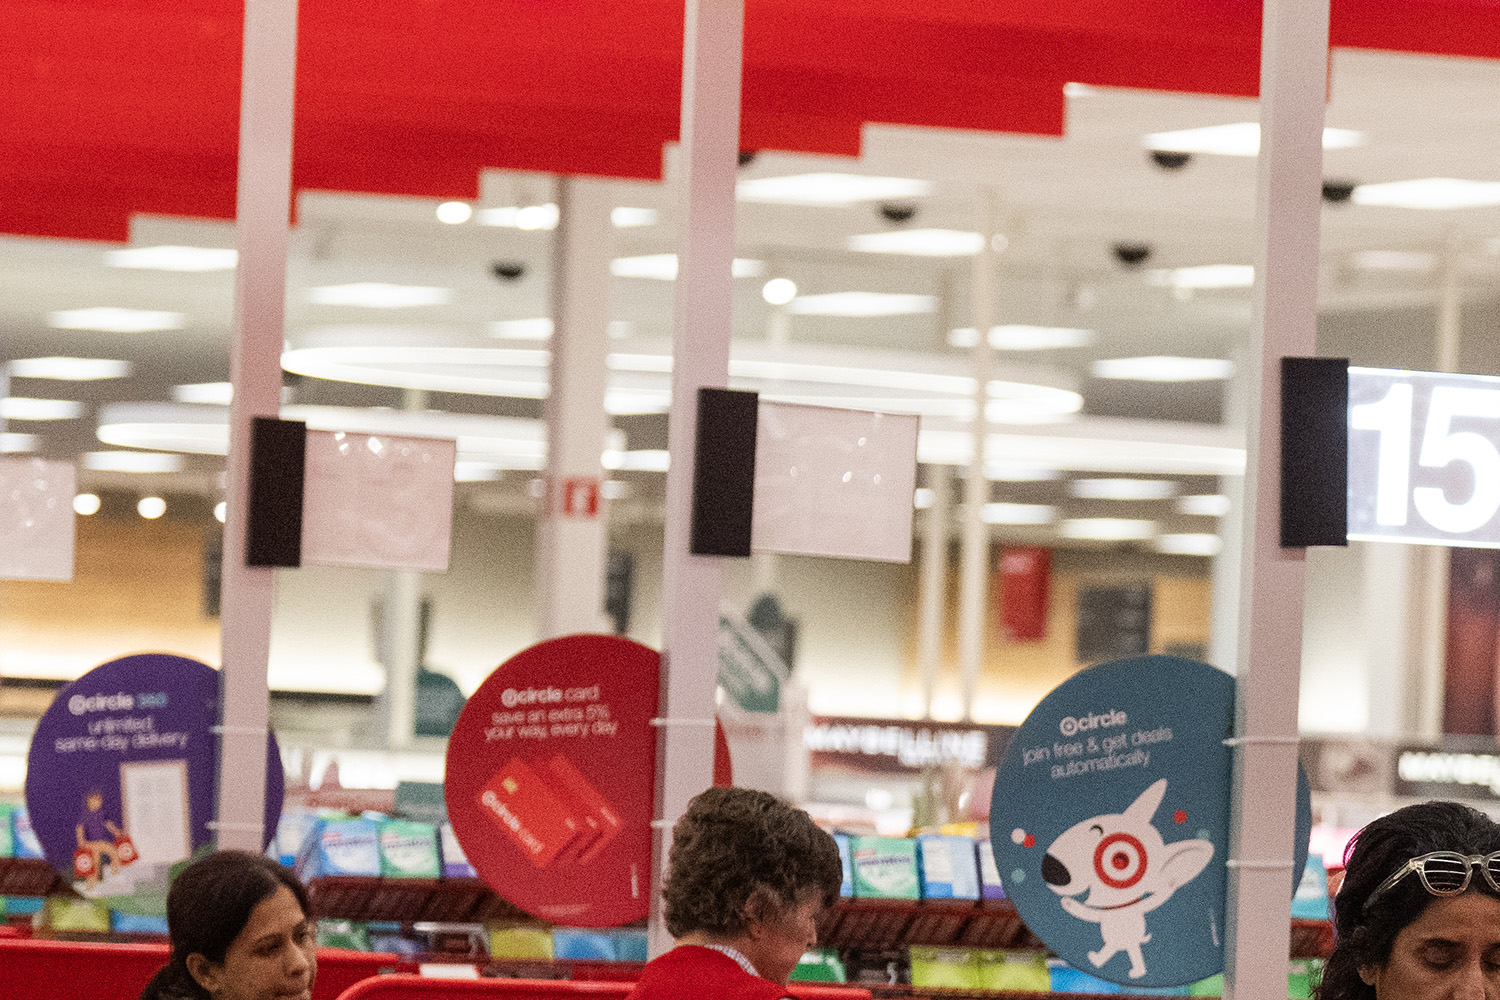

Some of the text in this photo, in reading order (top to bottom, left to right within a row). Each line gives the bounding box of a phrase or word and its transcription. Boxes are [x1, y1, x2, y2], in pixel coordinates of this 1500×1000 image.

[85, 691, 134, 712] circle
[517, 684, 600, 704] circle card
[87, 716, 154, 736] unlimited
[491, 711, 525, 726] save
[527, 709, 547, 723] an
[548, 707, 584, 722] extra
[1078, 708, 1128, 732] circle
[131, 732, 189, 751] delivery
[484, 725, 515, 743] your
[550, 722, 590, 739] every
[591, 720, 618, 738] day
[1022, 726, 1174, 767] join free & get deals
[1051, 750, 1149, 779] automatically
